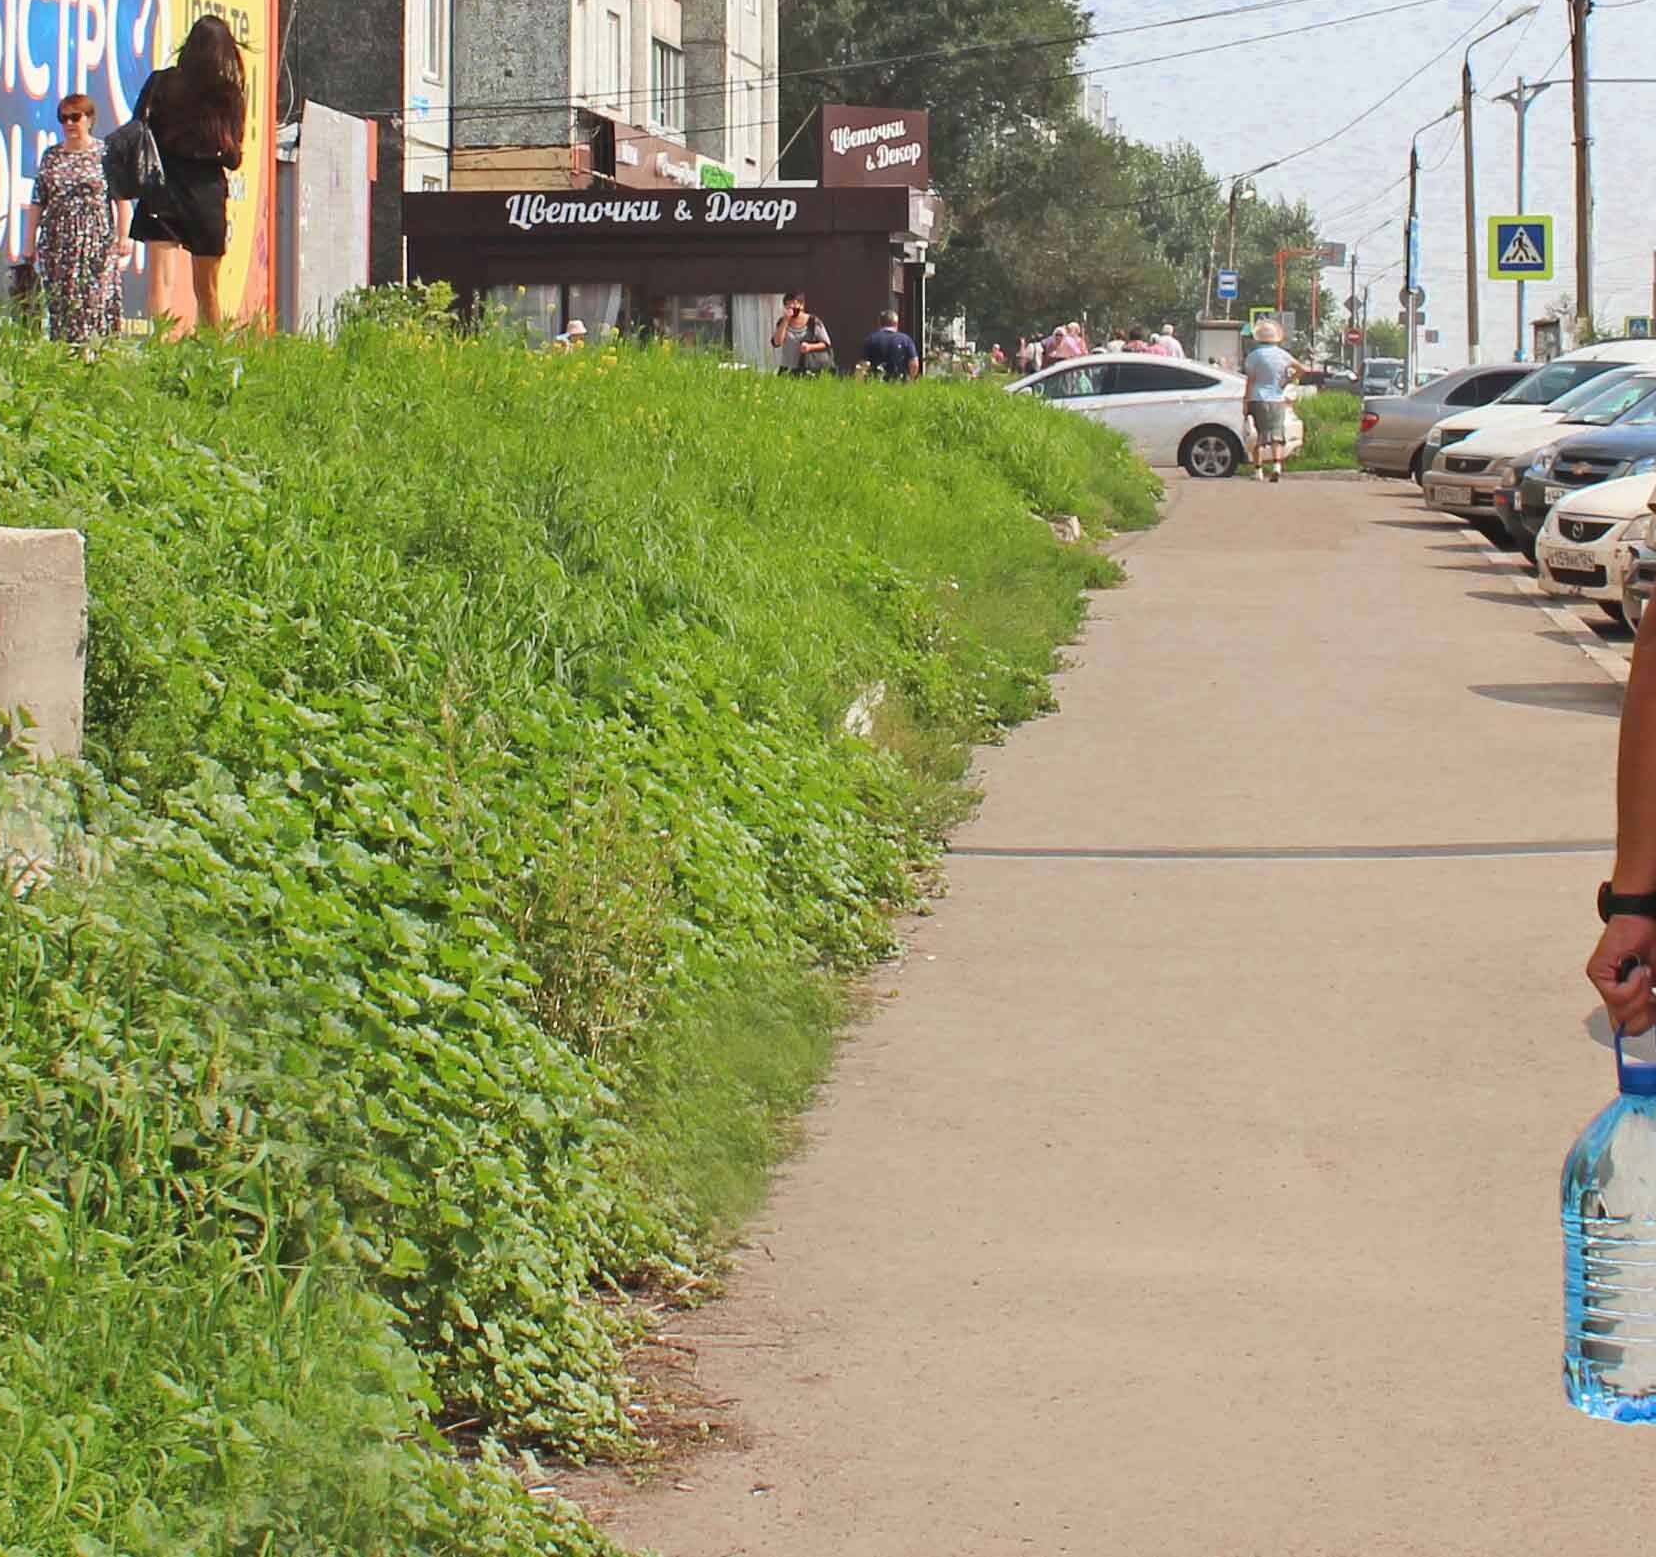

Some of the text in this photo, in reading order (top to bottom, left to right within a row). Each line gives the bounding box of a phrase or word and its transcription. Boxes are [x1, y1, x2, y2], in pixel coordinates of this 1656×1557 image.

[830, 119, 906, 156] Цветочки
[876, 142, 921, 169] Декор
[505, 191, 797, 231] Цветочки & Декор
